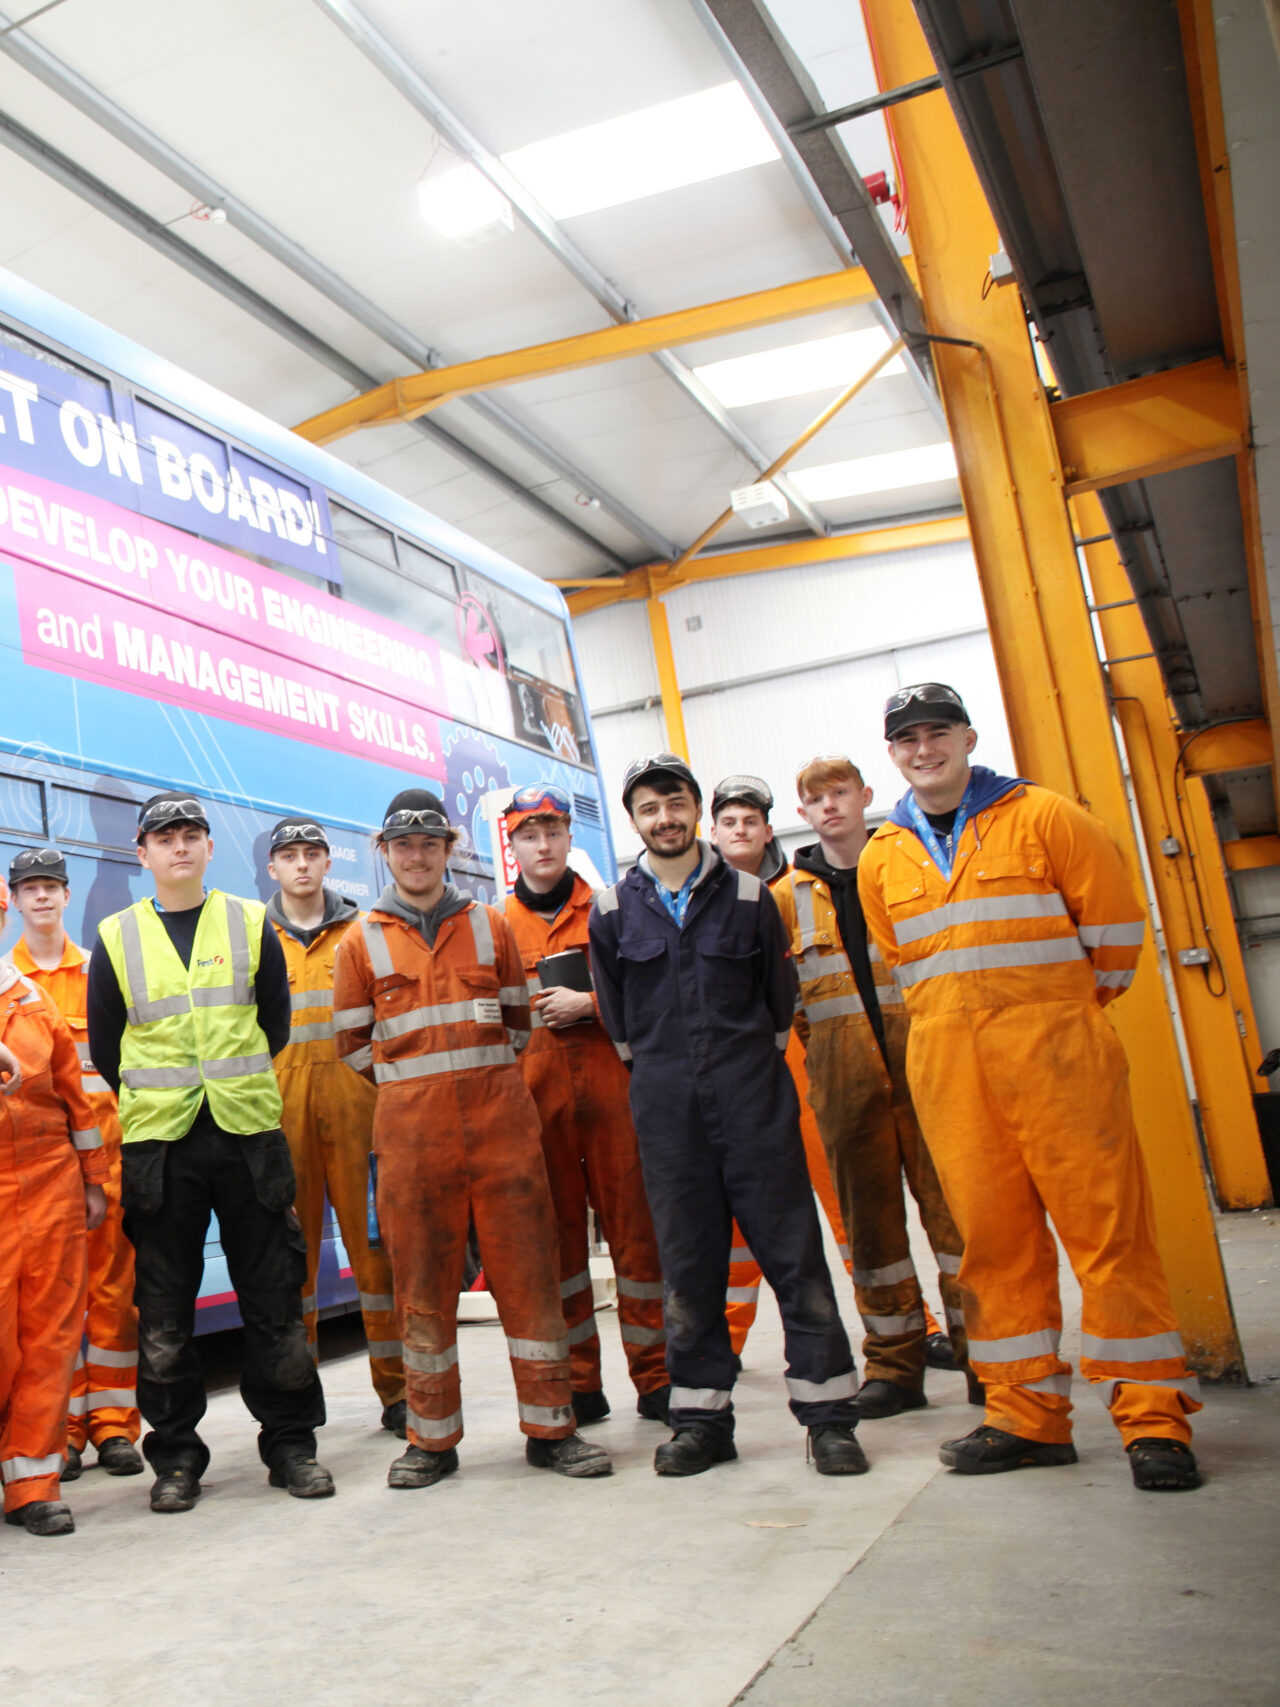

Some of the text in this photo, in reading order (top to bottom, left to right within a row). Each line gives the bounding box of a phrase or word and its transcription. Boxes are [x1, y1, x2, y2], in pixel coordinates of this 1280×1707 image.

[59, 400, 144, 485] ON
[151, 435, 327, 555] BOARD!
[36, 607, 436, 763] and MANAGEMENT SKILLS.
[164, 547, 258, 620] YOUR
[262, 586, 436, 687] ENGINEERING
